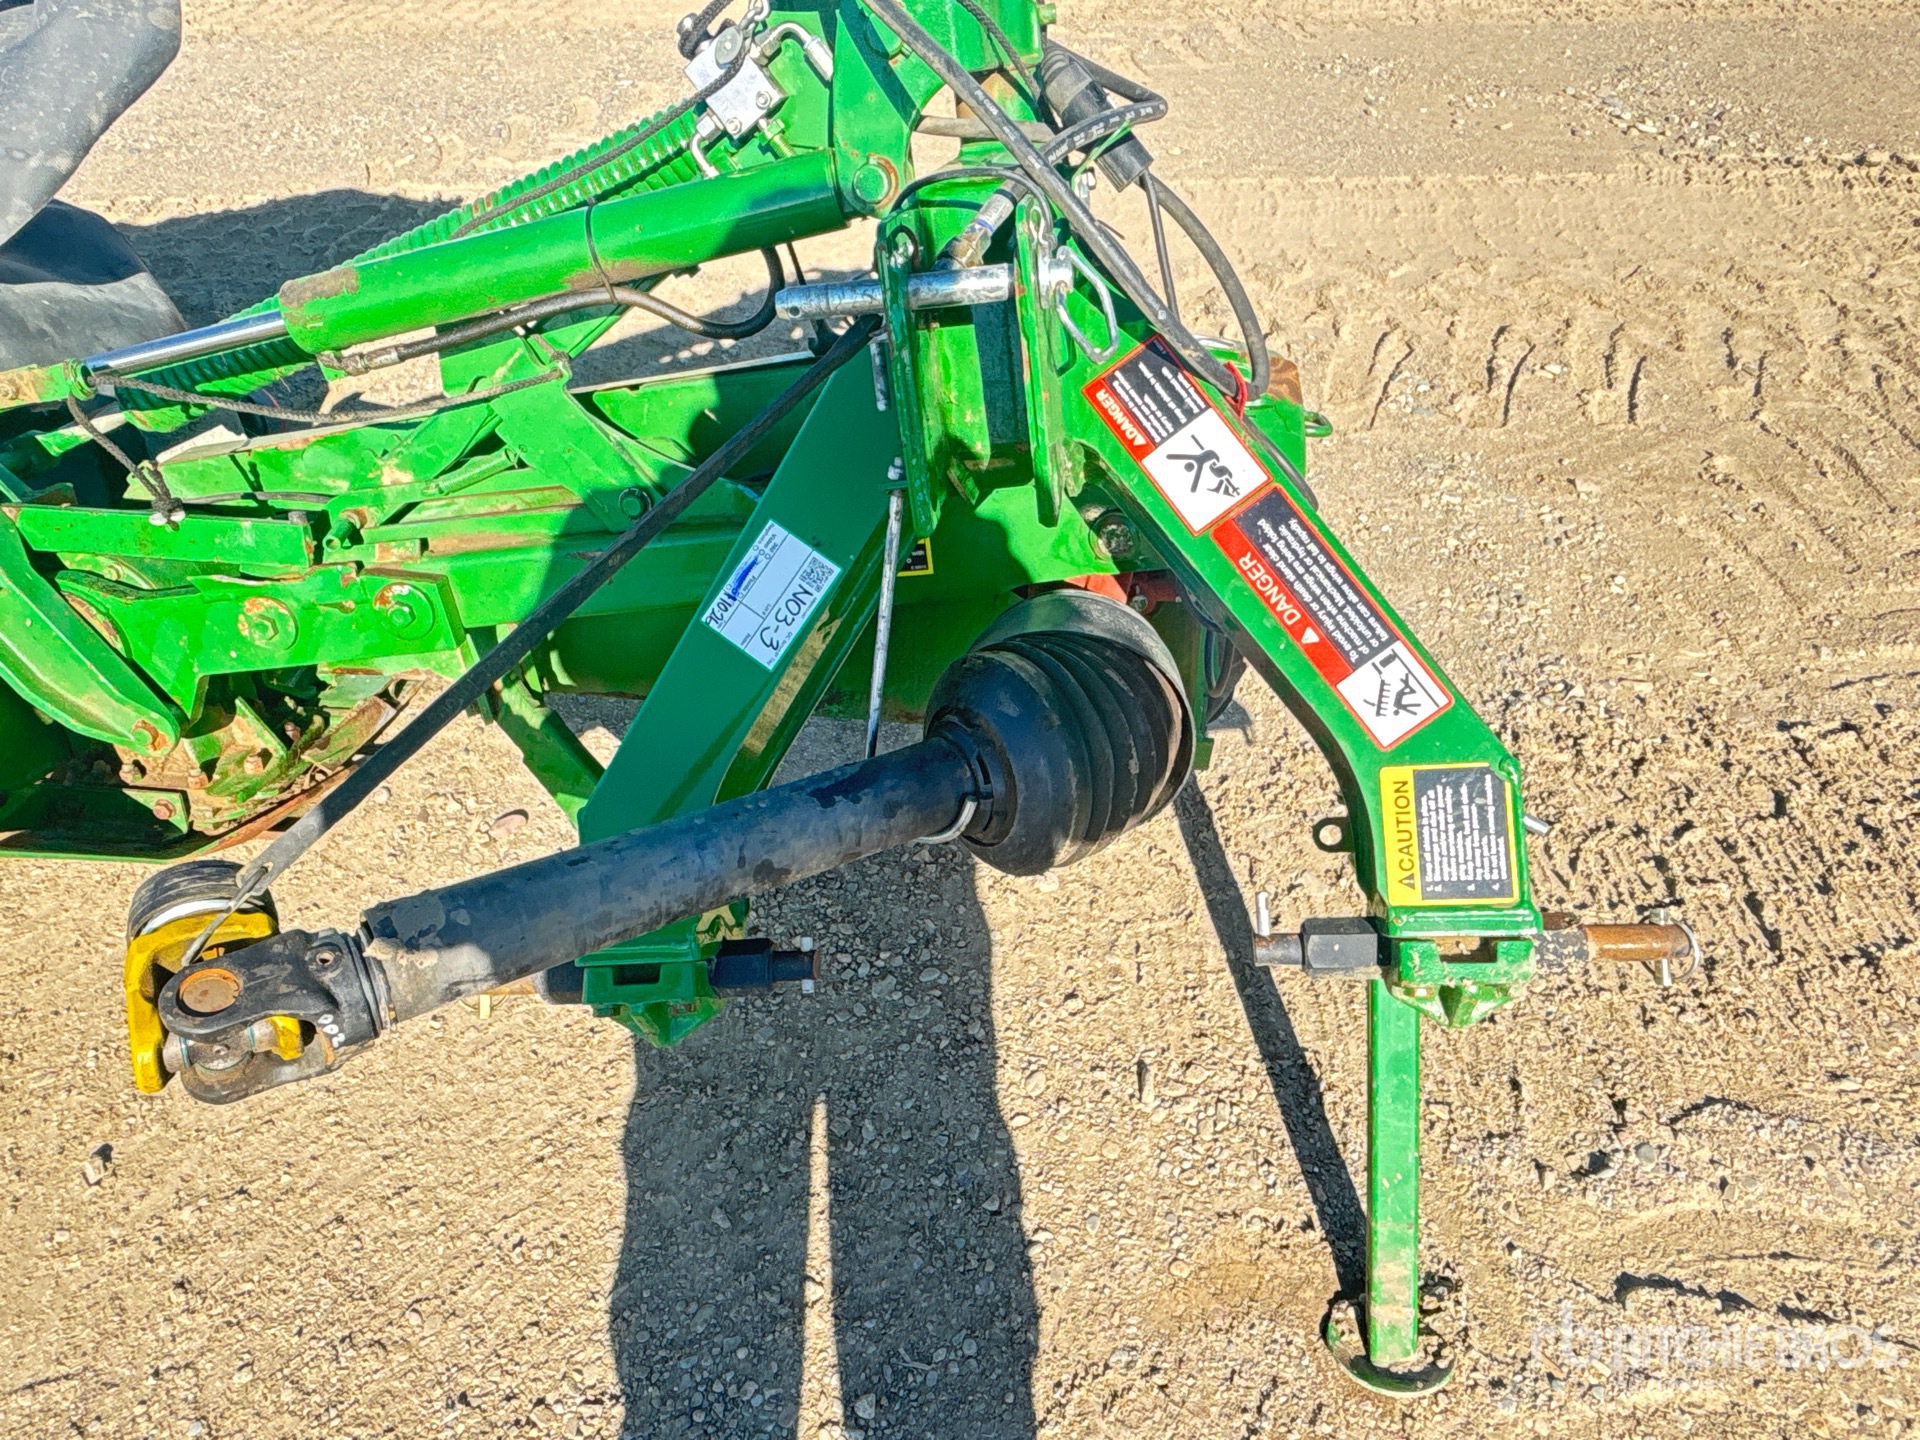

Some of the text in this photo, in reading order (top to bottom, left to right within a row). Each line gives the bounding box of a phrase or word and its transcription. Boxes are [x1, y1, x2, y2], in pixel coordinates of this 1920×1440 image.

[1094, 387, 1139, 440] DANGER
[762, 532, 777, 550] Video
[1236, 550, 1302, 626] DANGER
[1256, 517, 1370, 656] of machine when wings are being folded
[1276, 522, 1380, 648] or unfolded. Mechanical or hydraulic
[1286, 515, 1389, 642] failure can allow wings to fall rapidly.
[1261, 541, 1360, 662] To avoid injury or death stand clear
[1392, 780, 1414, 871] CAUTION
